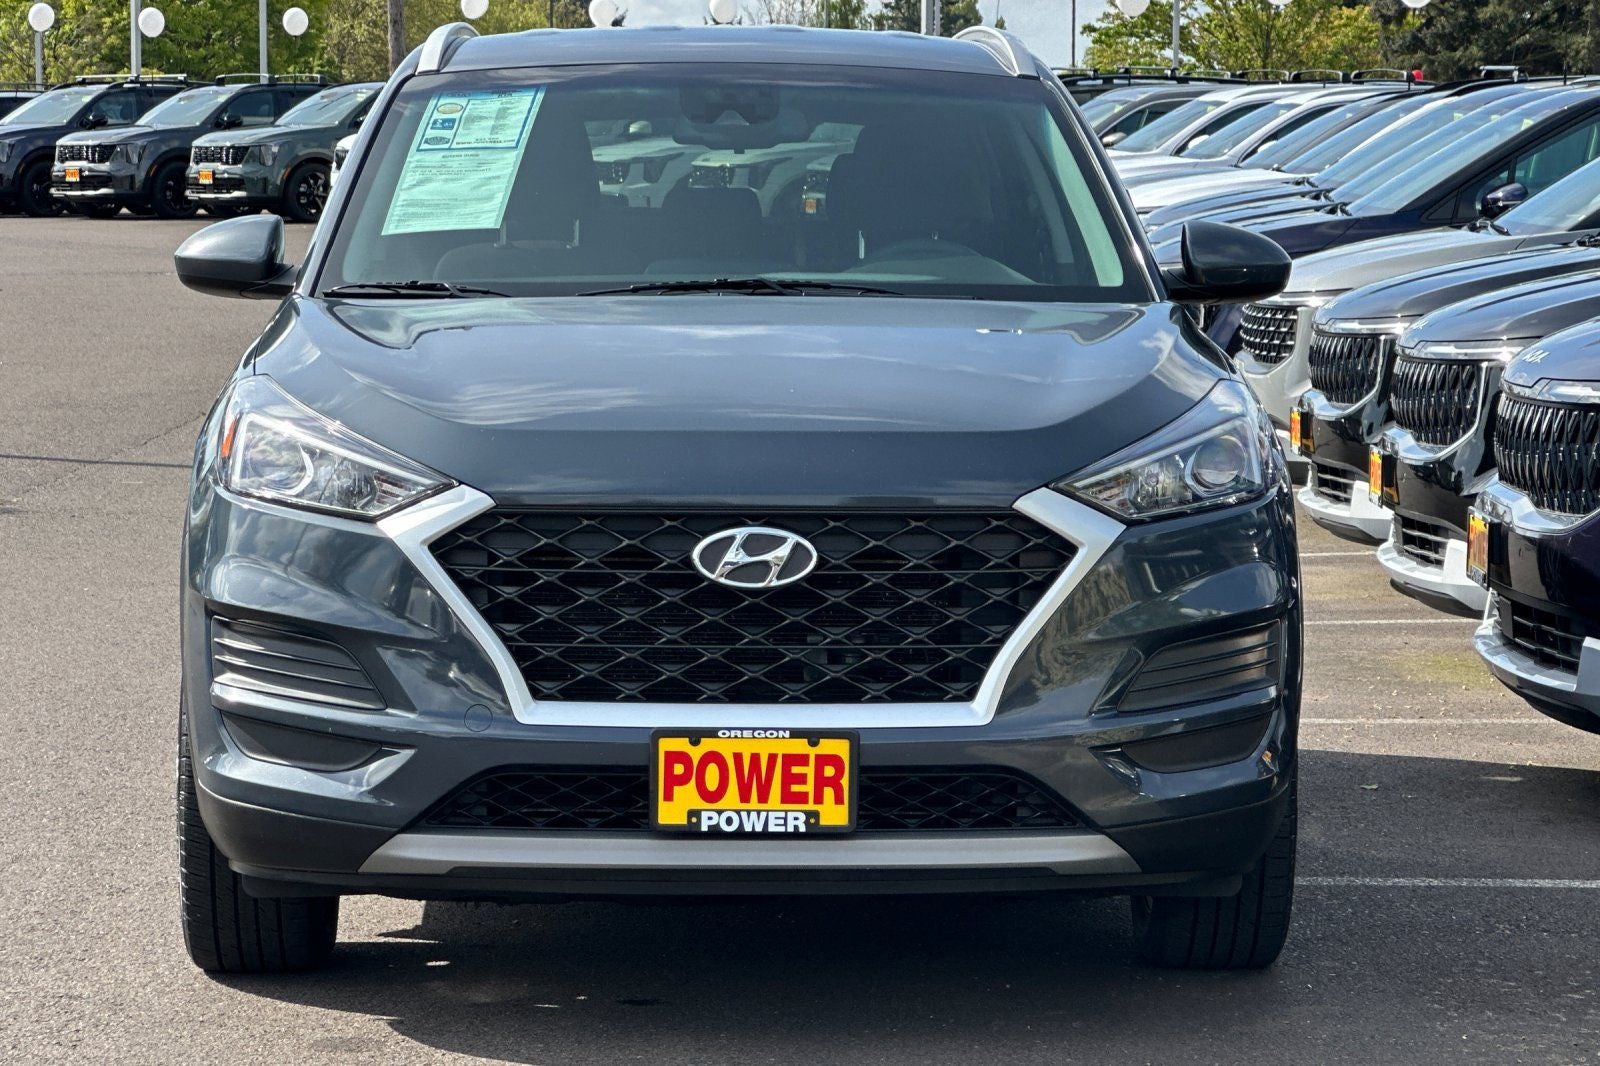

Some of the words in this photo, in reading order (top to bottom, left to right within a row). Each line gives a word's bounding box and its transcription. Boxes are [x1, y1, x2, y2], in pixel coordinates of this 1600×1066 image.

[717, 730, 790, 739] OREGON
[663, 750, 846, 805] POWER
[700, 810, 806, 833] POWER
